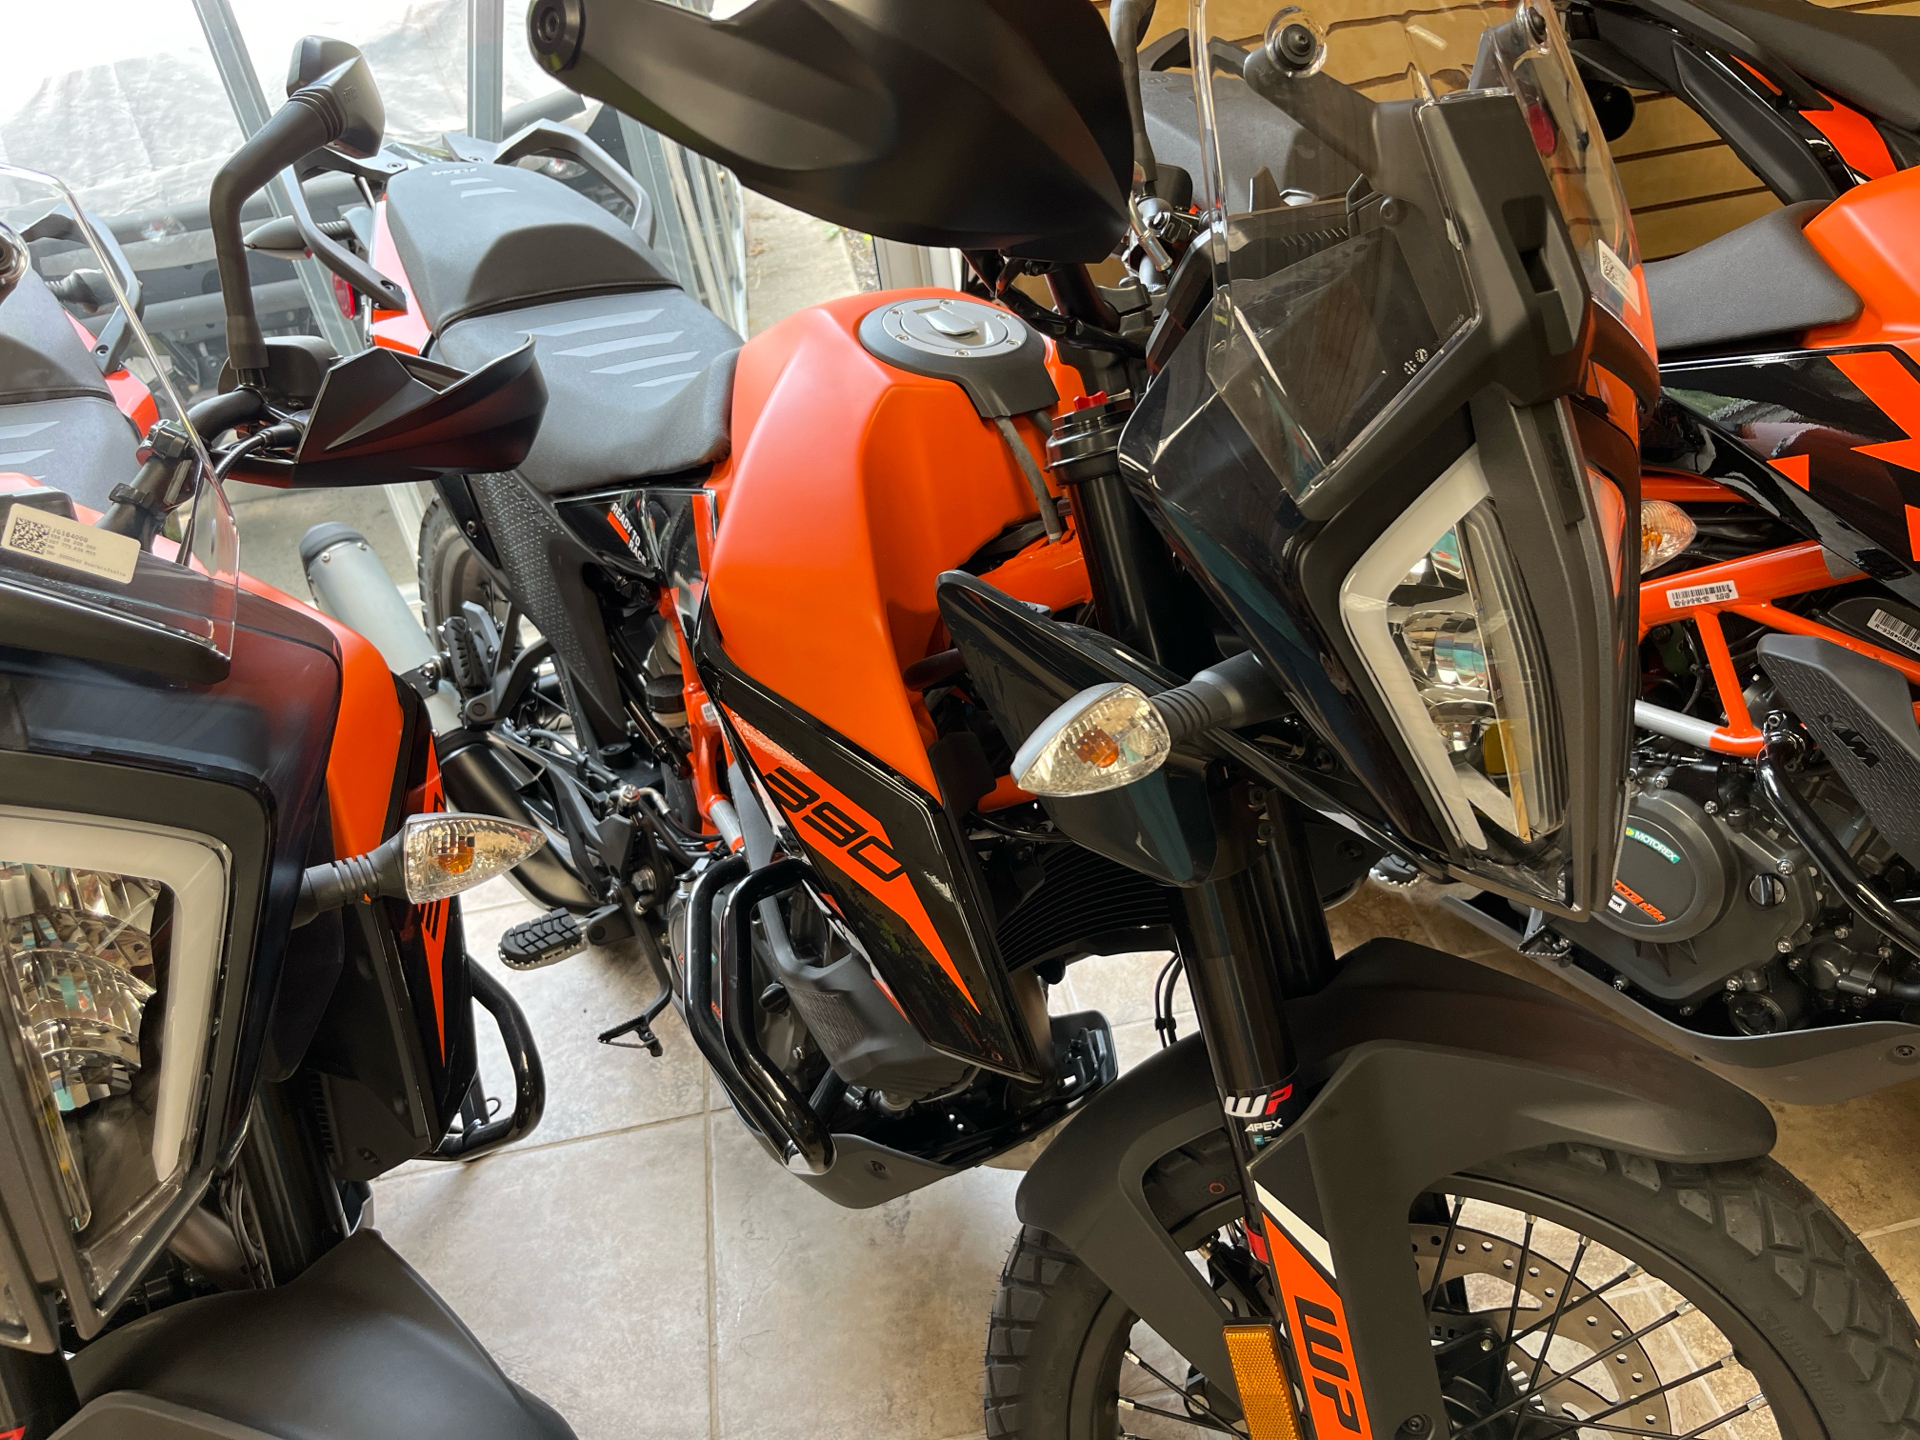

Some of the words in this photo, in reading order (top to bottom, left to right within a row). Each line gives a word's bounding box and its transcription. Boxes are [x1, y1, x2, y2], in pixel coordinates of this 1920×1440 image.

[611, 502, 633, 534] READY
[632, 530, 641, 547] TO
[628, 539, 647, 567] RACE
[764, 766, 907, 882] 390
[1634, 830, 1677, 862] MOTOREX
[1224, 1083, 1293, 1118] WP
[1245, 1118, 1283, 1132] APEX
[1294, 1295, 1361, 1434] WP
